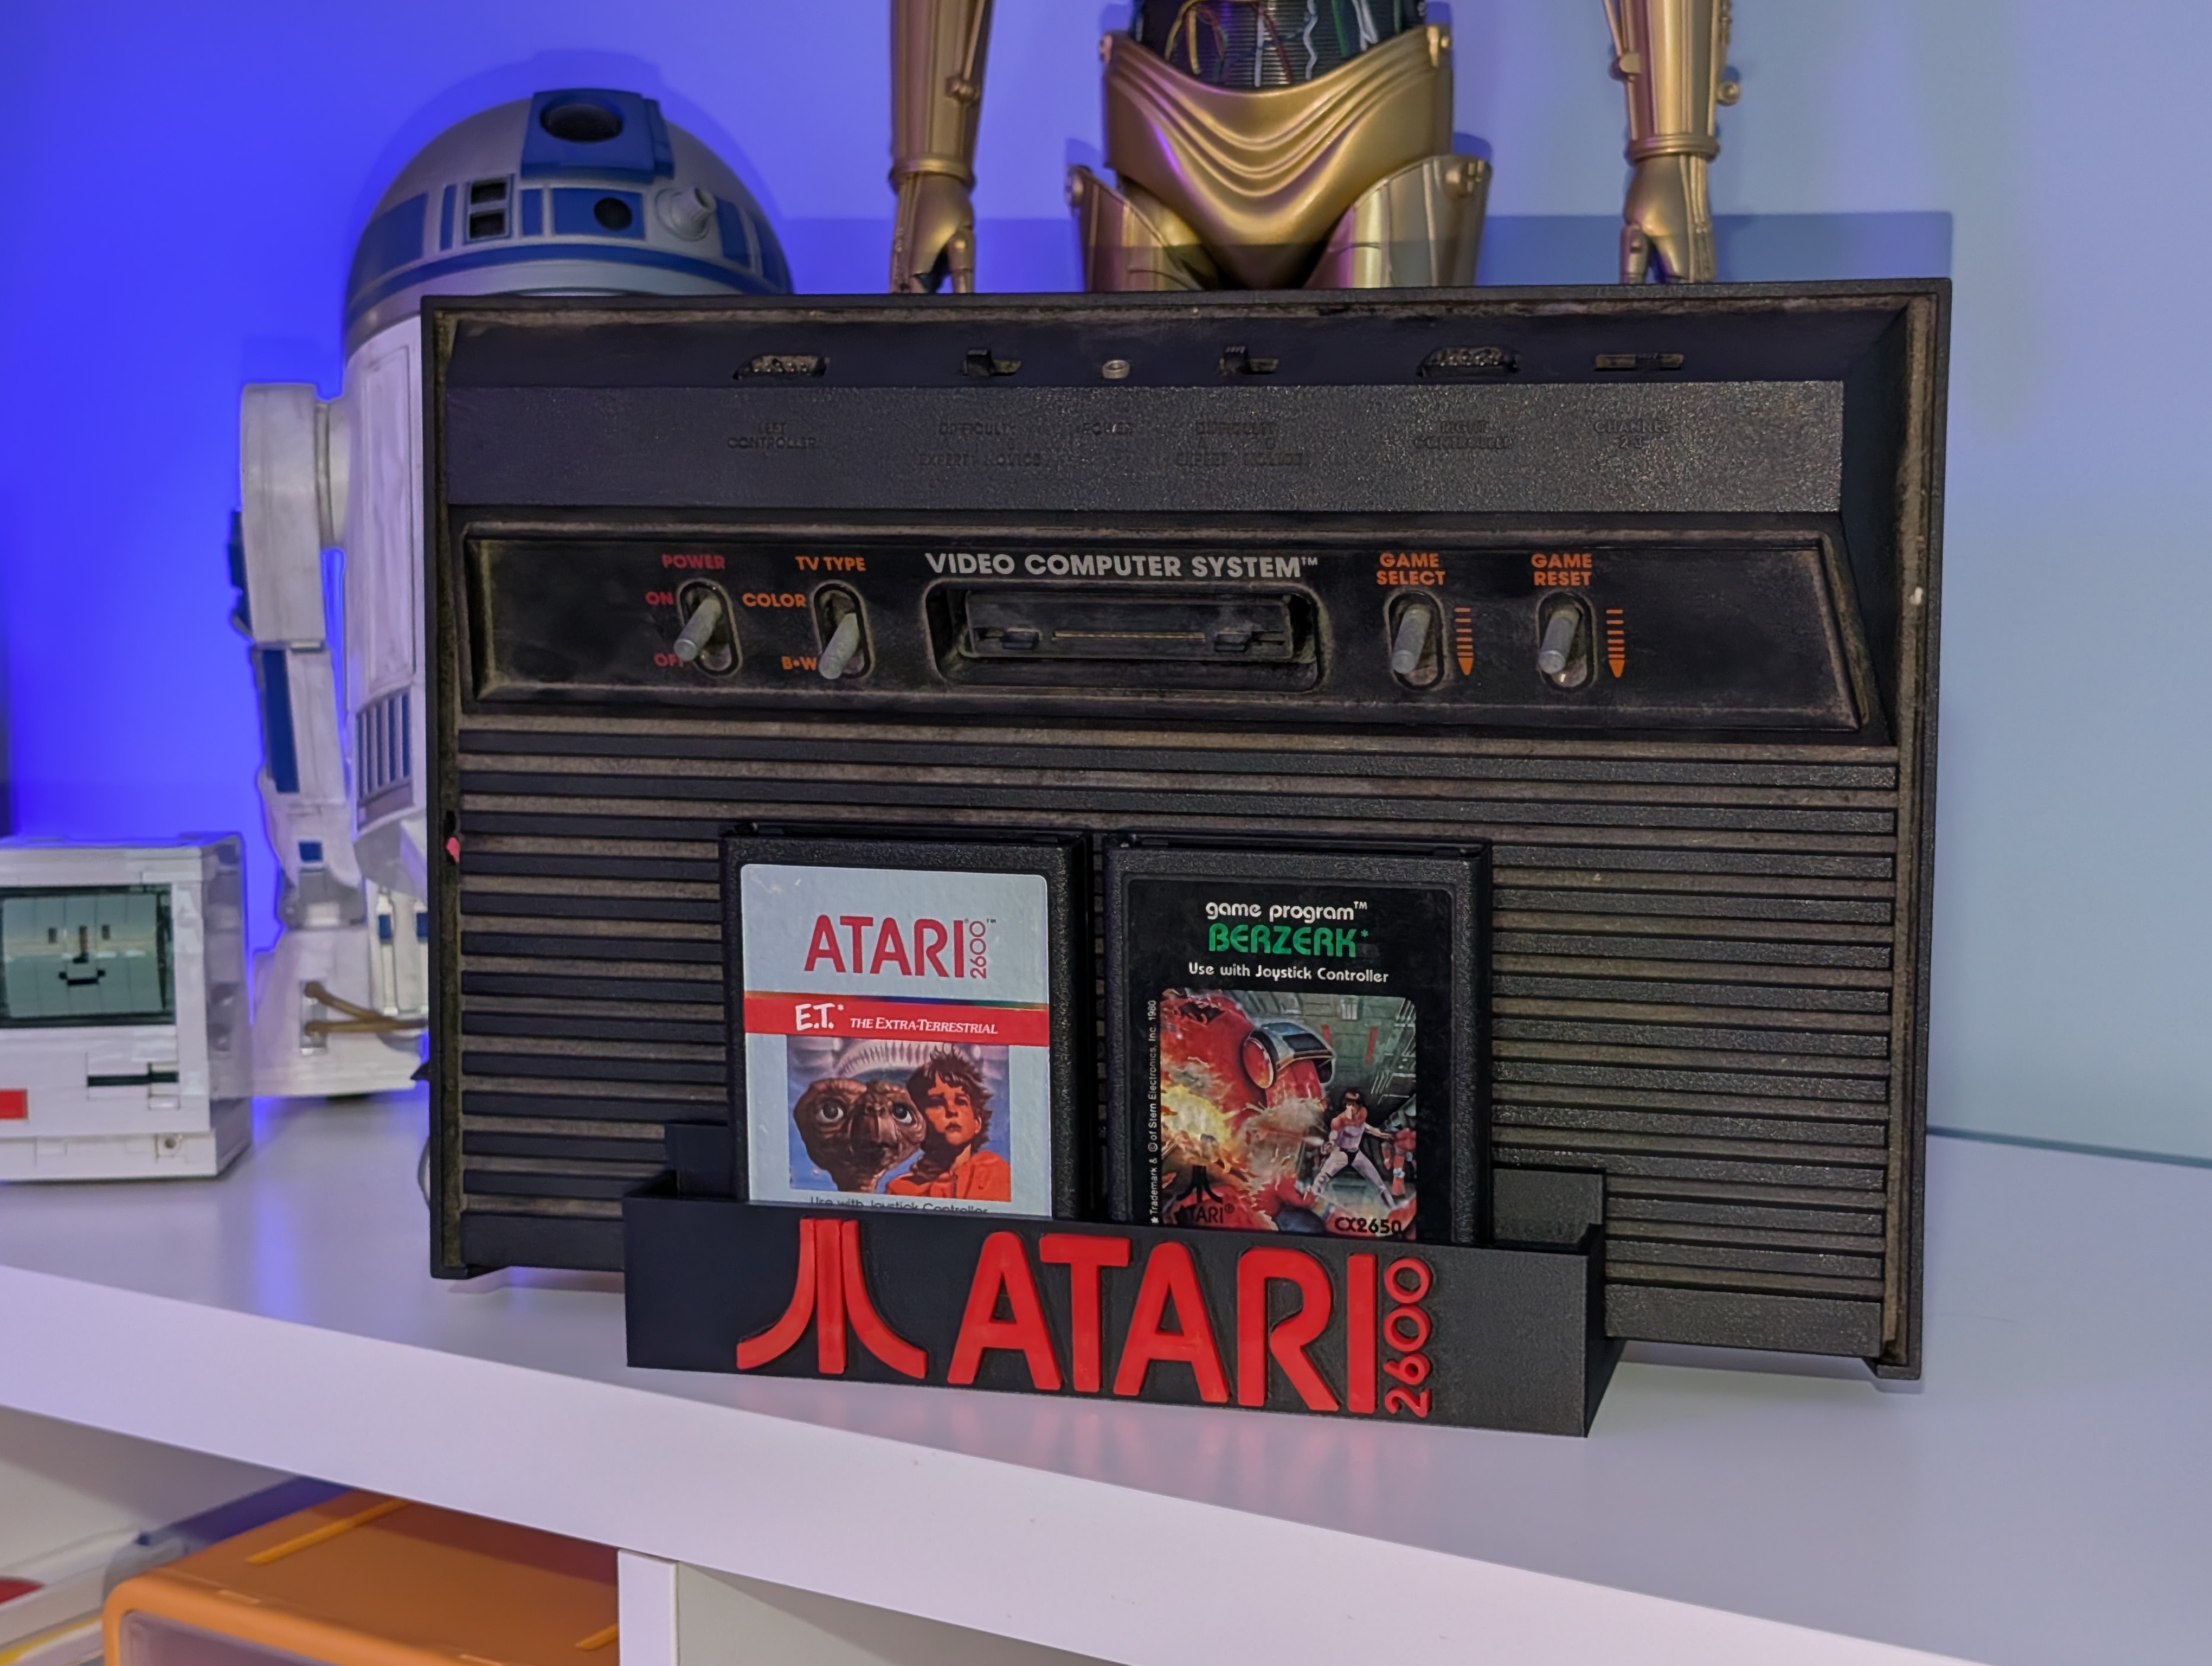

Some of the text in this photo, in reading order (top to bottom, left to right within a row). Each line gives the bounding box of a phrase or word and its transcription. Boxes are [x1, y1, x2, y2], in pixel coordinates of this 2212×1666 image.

[662, 554, 725, 569] POWER
[795, 556, 866, 572] TV TYPE
[924, 553, 1015, 575] VIDEO
[1024, 554, 1182, 578] COMPUTER
[1379, 552, 1439, 568] GAME
[1531, 553, 1592, 569] GAME
[1376, 570, 1446, 586] SELECT
[1534, 570, 1592, 586] RESET
[646, 592, 673, 606] ON
[742, 593, 806, 608] COLOR
[1205, 902, 1262, 920] game
[804, 915, 964, 978] ATARI
[1188, 962, 1389, 983] Use with Joystick Controller
[1147, 1000, 1157, 1021] 1980
[850, 1017, 874, 1029] THE
[1148, 1103, 1158, 1128] Stern
[1334, 1216, 1402, 1234] CX2650
[947, 1231, 1377, 1413] ATARI
[1384, 1257, 1432, 1418] 2600
